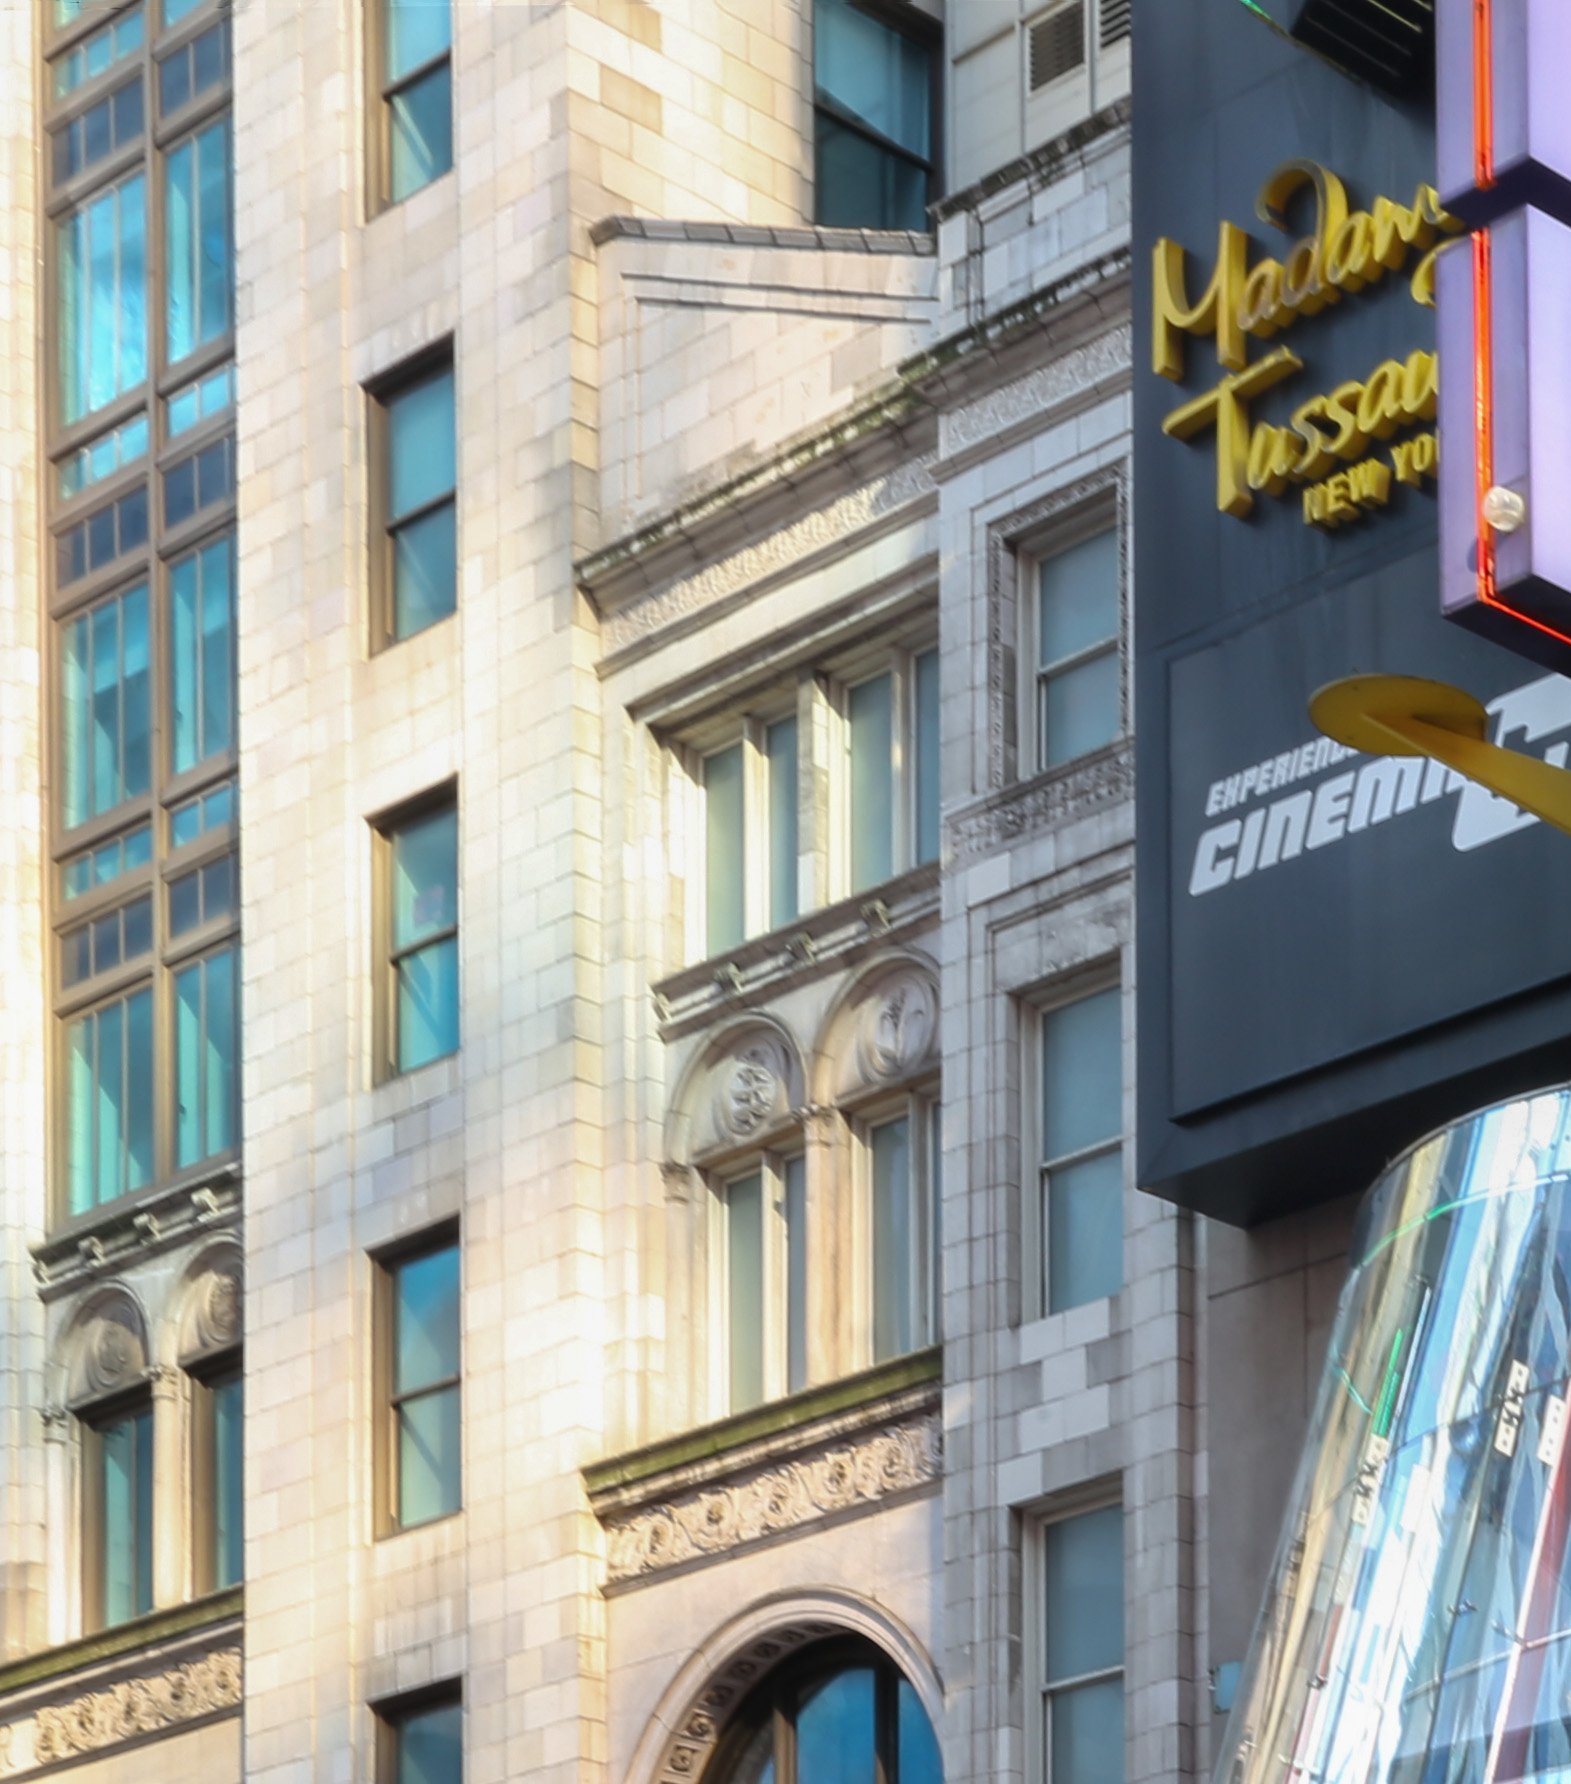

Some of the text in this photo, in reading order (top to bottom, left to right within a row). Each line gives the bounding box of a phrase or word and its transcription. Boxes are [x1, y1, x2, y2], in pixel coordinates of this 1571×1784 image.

[1152, 158, 1464, 382] Madam
[1162, 345, 1438, 519] Tussau
[1303, 432, 1439, 525] NEW YO
[1205, 735, 1361, 816] EXPERIENC
